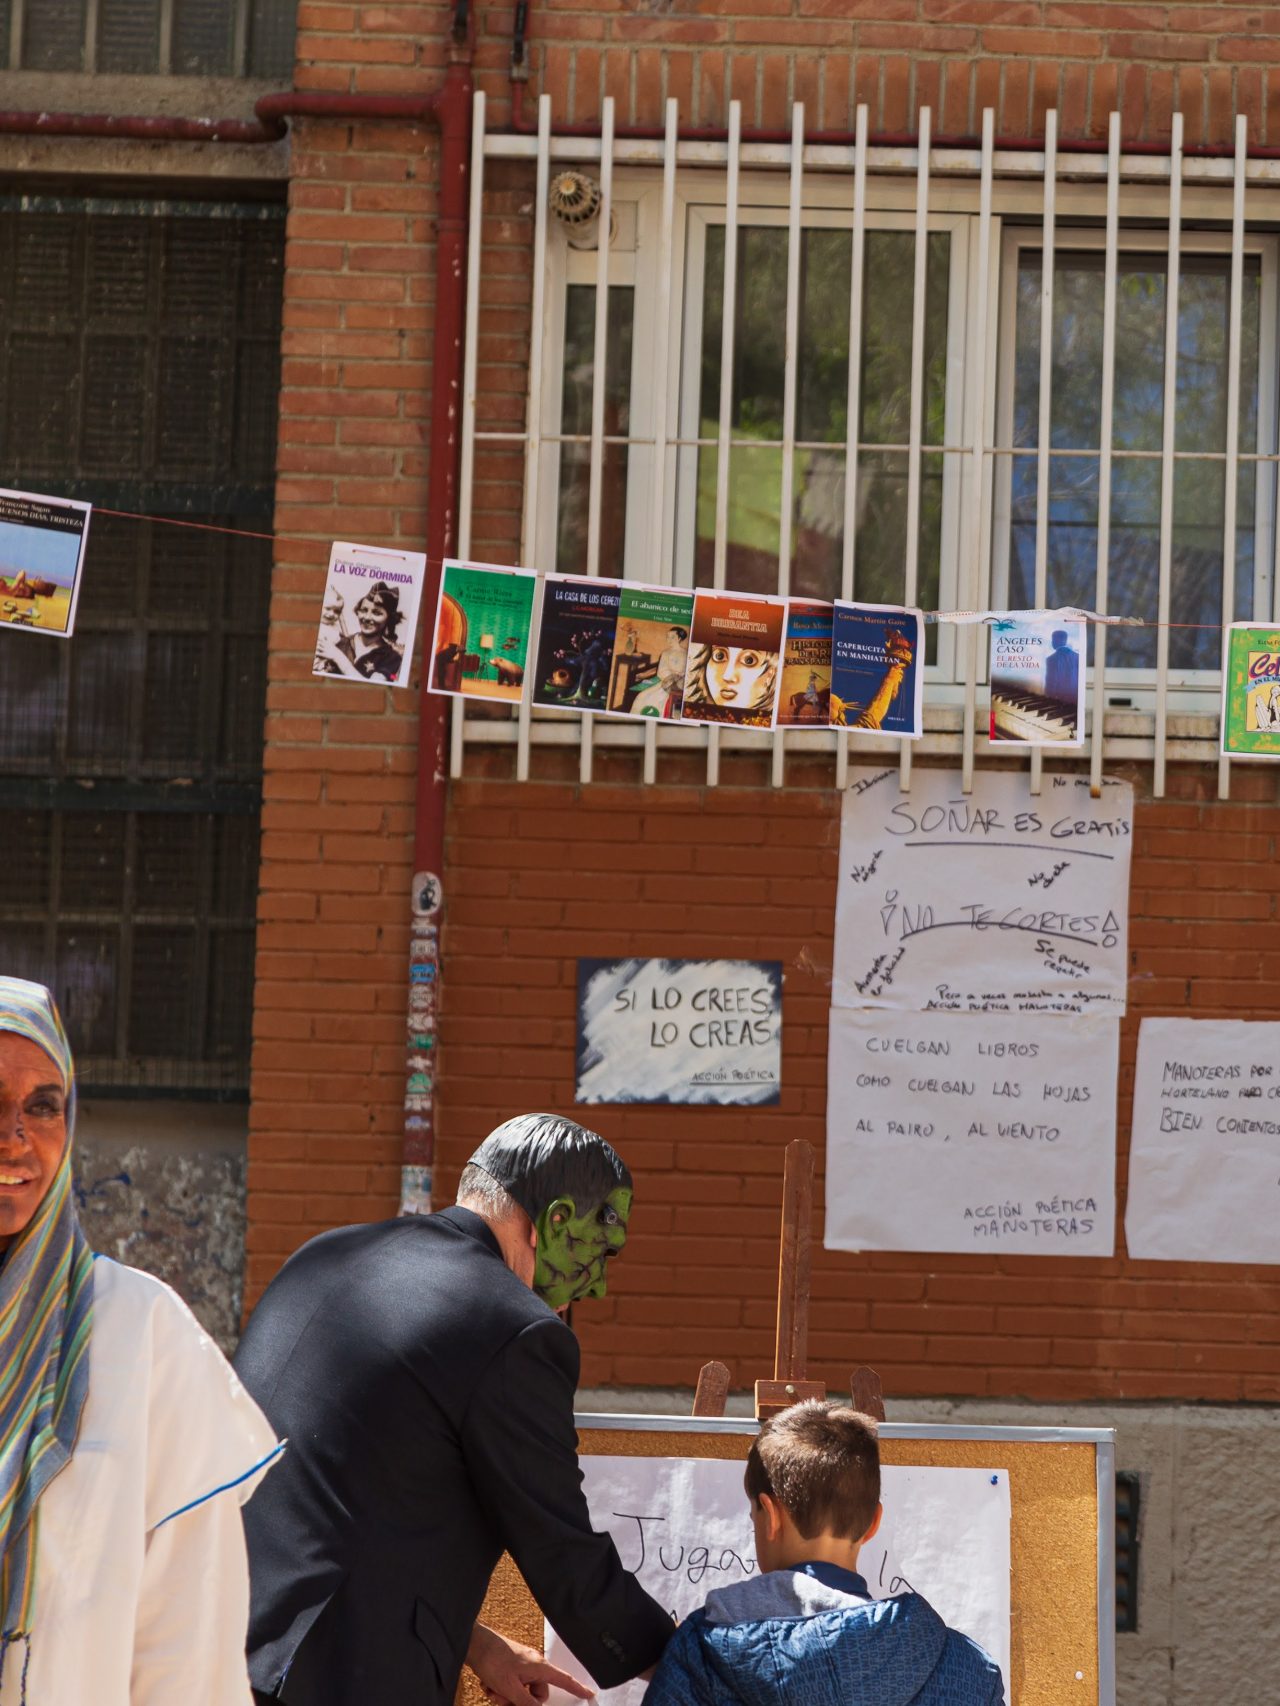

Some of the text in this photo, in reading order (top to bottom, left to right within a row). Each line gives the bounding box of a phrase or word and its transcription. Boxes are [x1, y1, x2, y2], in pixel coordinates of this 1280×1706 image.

[334, 563, 345, 573] LA
[349, 565, 367, 577] VOZ
[369, 568, 413, 584] DORMIDA
[555, 590, 599, 604] LA CASA DE LOS
[640, 602, 668, 611] abanico
[837, 642, 886, 653] CAPERUCITA
[850, 652, 900, 664] MANHATTAN
[884, 800, 1005, 836] SOÑAR
[1013, 812, 1043, 833] ES
[1034, 939, 1055, 958] Se
[613, 988, 637, 1012] SI
[651, 986, 682, 1011] LO
[936, 984, 961, 1000] Pero
[651, 1019, 771, 1048] LO CREAS
[866, 1037, 1040, 1058] CUELGAN LIBROS
[1162, 1061, 1241, 1082] MANOTERAS
[1250, 1065, 1273, 1078] POR
[856, 1074, 1091, 1103] COMO CUELGAN LAS HOJAS
[1160, 1087, 1230, 1099] HORTELANO
[855, 1119, 874, 1133] AL
[887, 1122, 935, 1138] PAIRO
[967, 1122, 988, 1137] AL
[1160, 1107, 1202, 1133] BIEN
[963, 1202, 1022, 1219] ACCIÓN
[973, 1217, 1095, 1239] MANOTERAS
